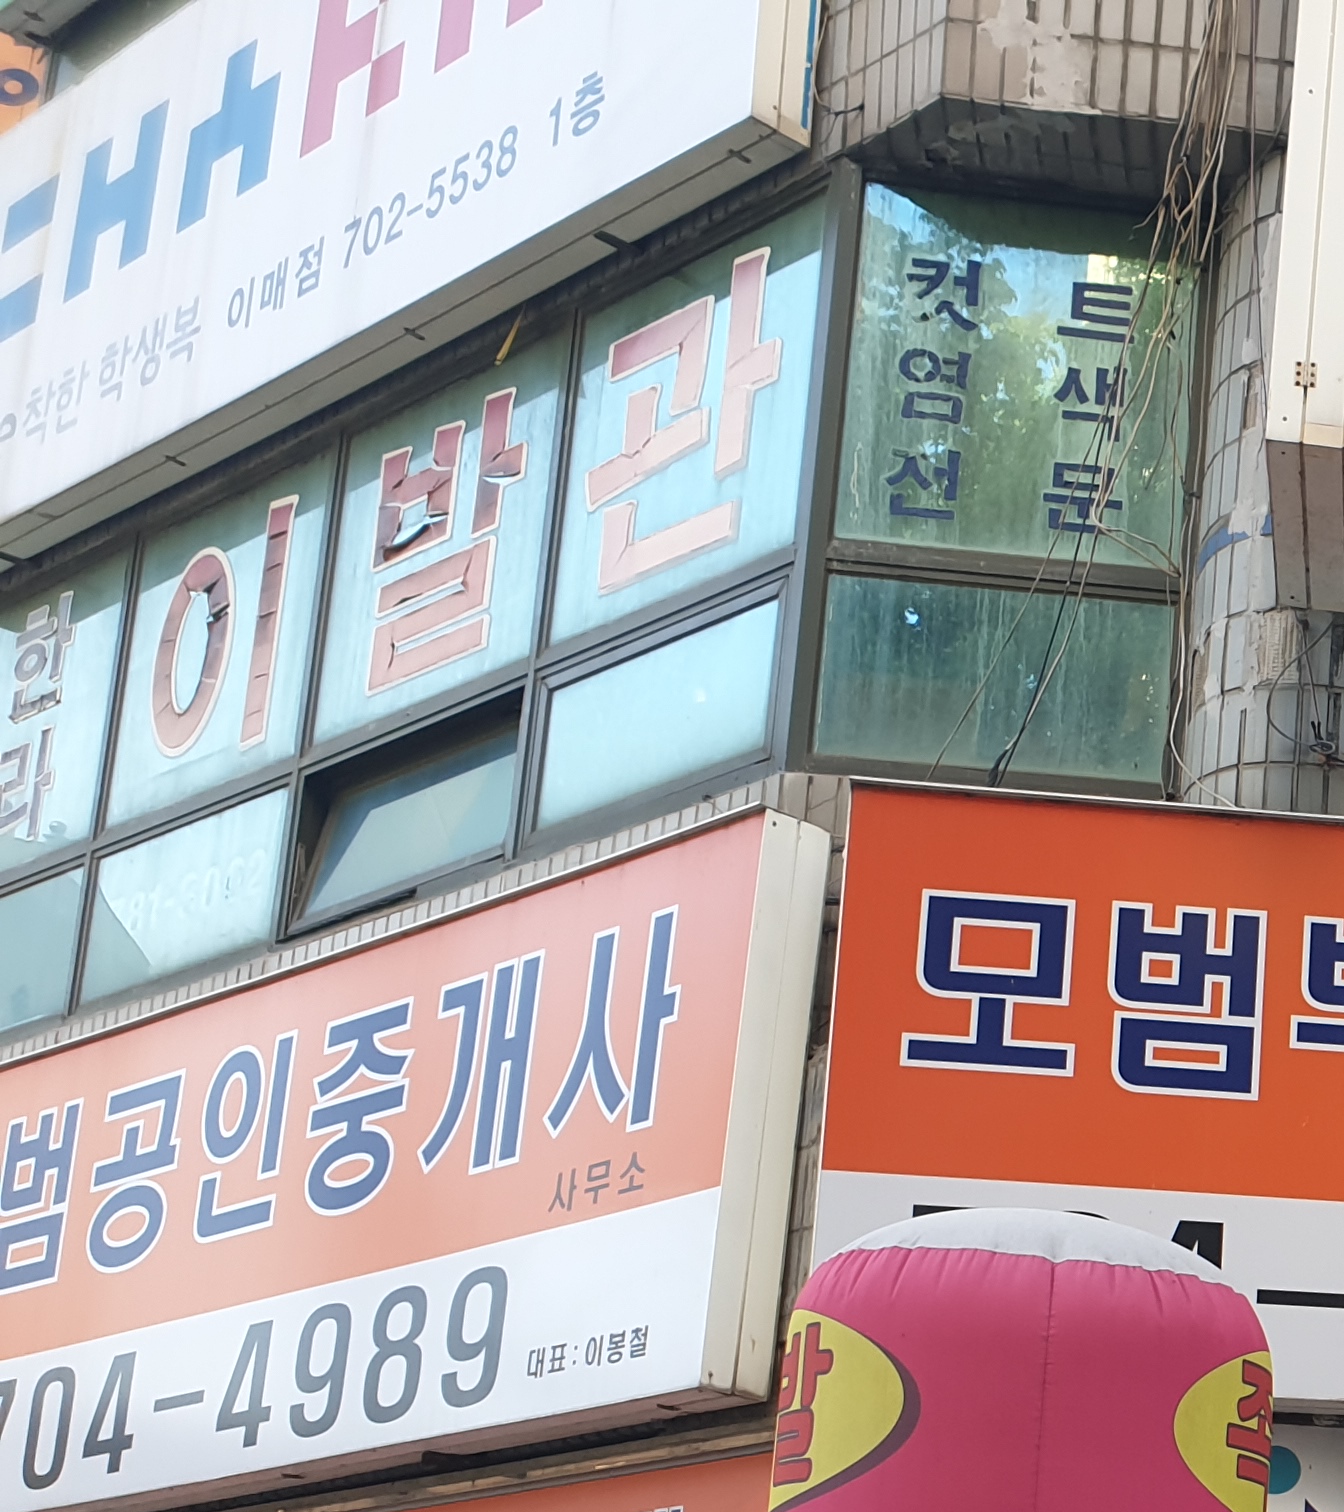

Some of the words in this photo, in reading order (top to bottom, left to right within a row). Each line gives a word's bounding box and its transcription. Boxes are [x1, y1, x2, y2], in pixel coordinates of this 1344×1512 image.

[97, 294, 202, 403] 학생복
[227, 234, 326, 329] 이매점
[342, 124, 520, 270] 702-5538
[549, 69, 606, 147] 1층
[545, 1151, 647, 1214] 사무소
[583, 1325, 650, 1369] 이봉철
